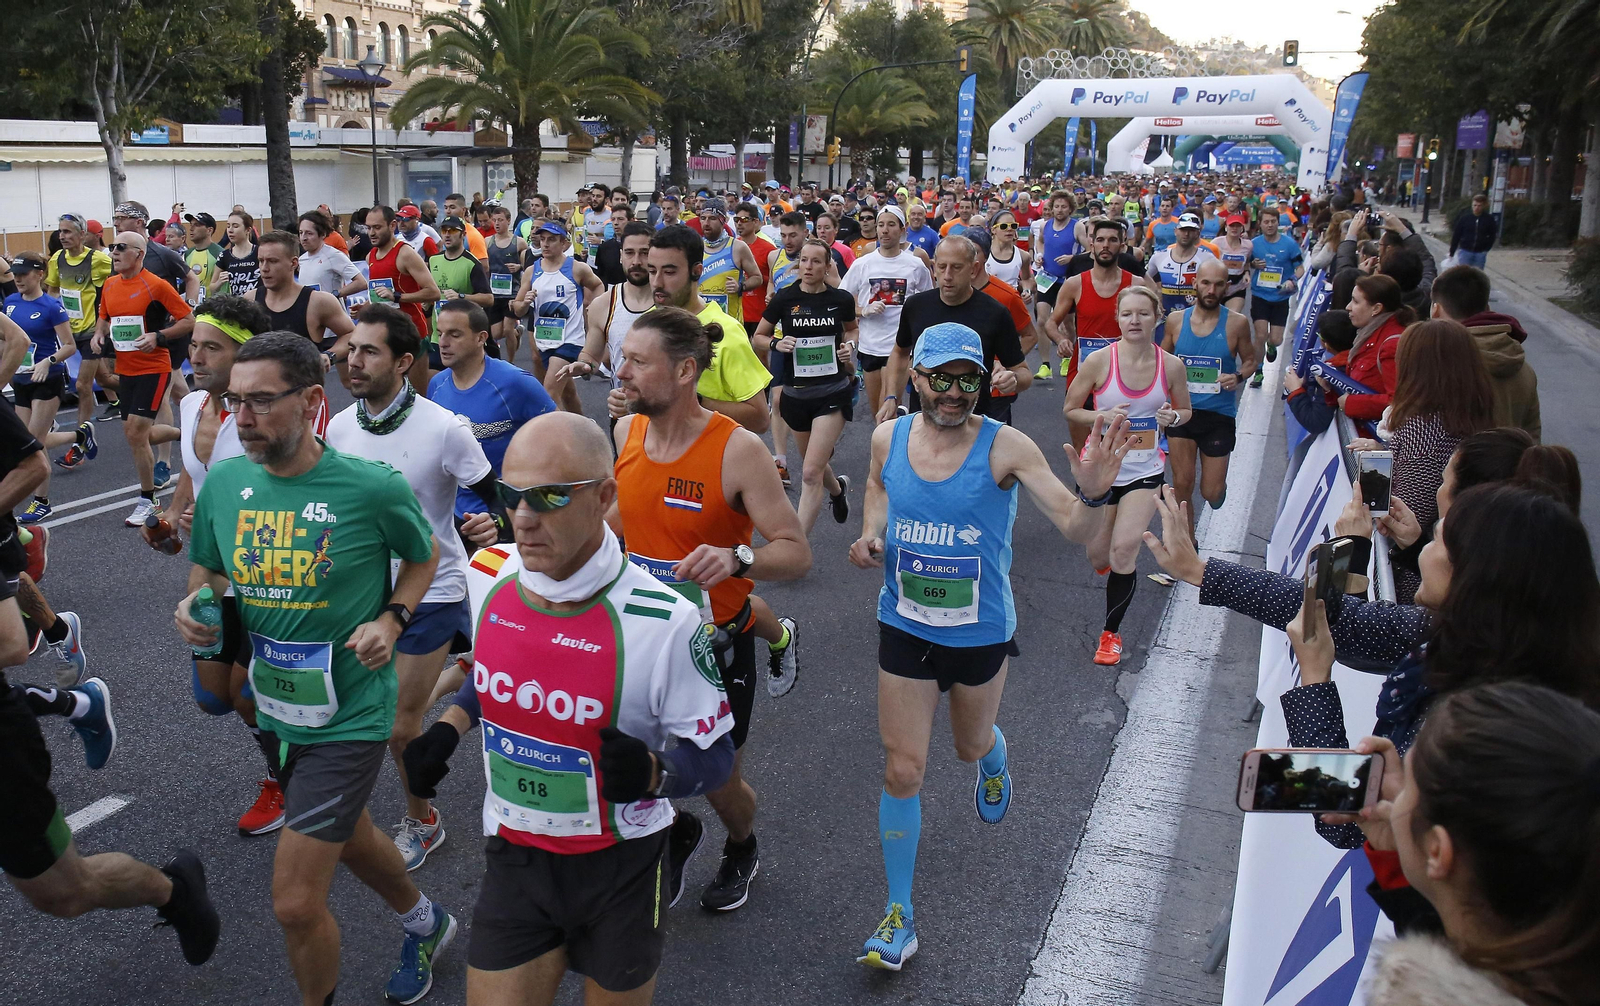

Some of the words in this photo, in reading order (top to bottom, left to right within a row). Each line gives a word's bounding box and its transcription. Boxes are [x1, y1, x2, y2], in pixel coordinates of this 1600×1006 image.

[1093, 91, 1149, 106] PayPal
[1196, 88, 1256, 105] PayPal
[1018, 100, 1043, 124] PayPal
[1293, 107, 1321, 133] PayPal
[1257, 118, 1282, 126] Helio
[792, 317, 834, 327] MARJAN
[1302, 307, 1318, 340] ZURICH
[807, 353, 823, 361] 3967
[1292, 349, 1304, 370] RICH
[1192, 371, 1204, 379] 749
[667, 476, 705, 500] FRITS
[301, 502, 337, 523] 45th
[235, 509, 307, 548] FINI-
[894, 521, 956, 546] rabbit
[232, 547, 317, 587] SHER
[651, 567, 676, 577] ZURIC
[925, 564, 959, 574] ZURICH
[255, 587, 267, 598] 10
[268, 588, 293, 599] 2017
[923, 586, 947, 599] 669
[551, 632, 602, 653] Javier
[272, 650, 306, 661] ZURICH
[273, 677, 296, 693] 723
[517, 745, 561, 763] ZURICH
[517, 778, 548, 798] 618
